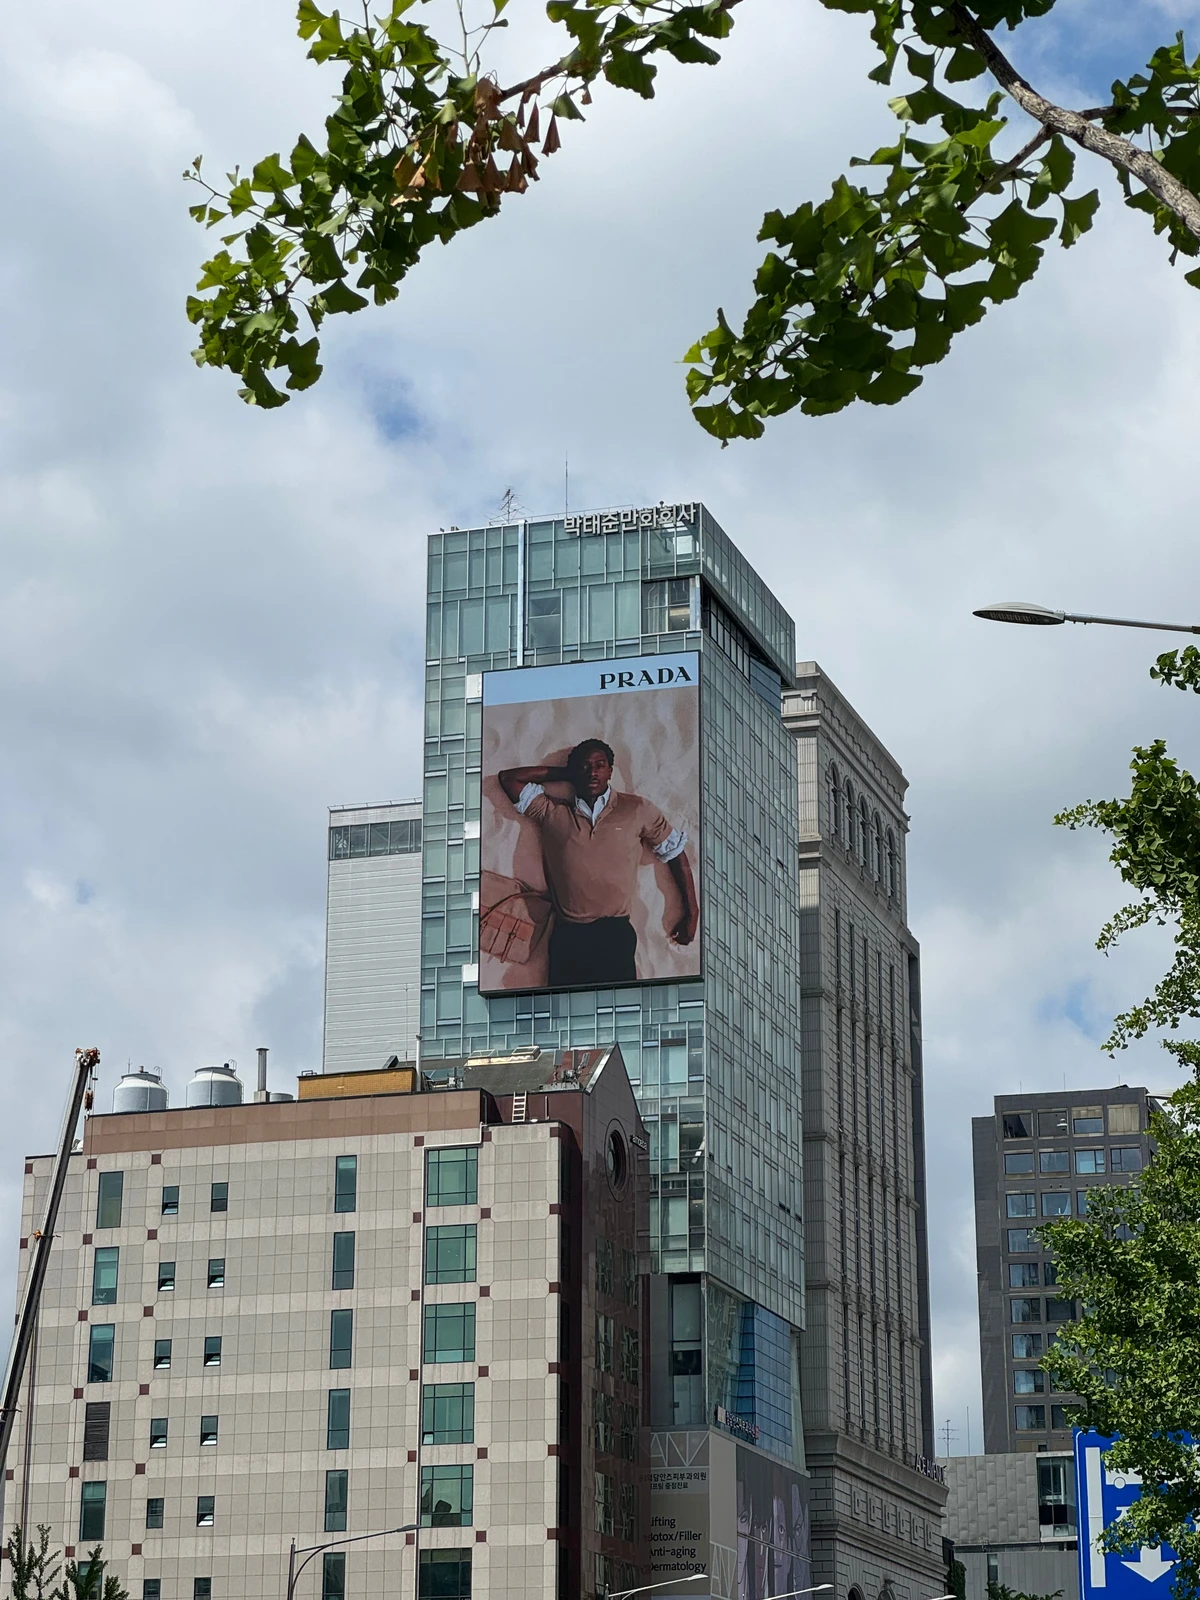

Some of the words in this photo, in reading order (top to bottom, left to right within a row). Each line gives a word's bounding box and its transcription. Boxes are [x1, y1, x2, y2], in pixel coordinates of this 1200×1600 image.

[563, 501, 697, 537] 박태준만화회사
[599, 666, 692, 690] PRADA
[651, 1516, 676, 1529] ifting
